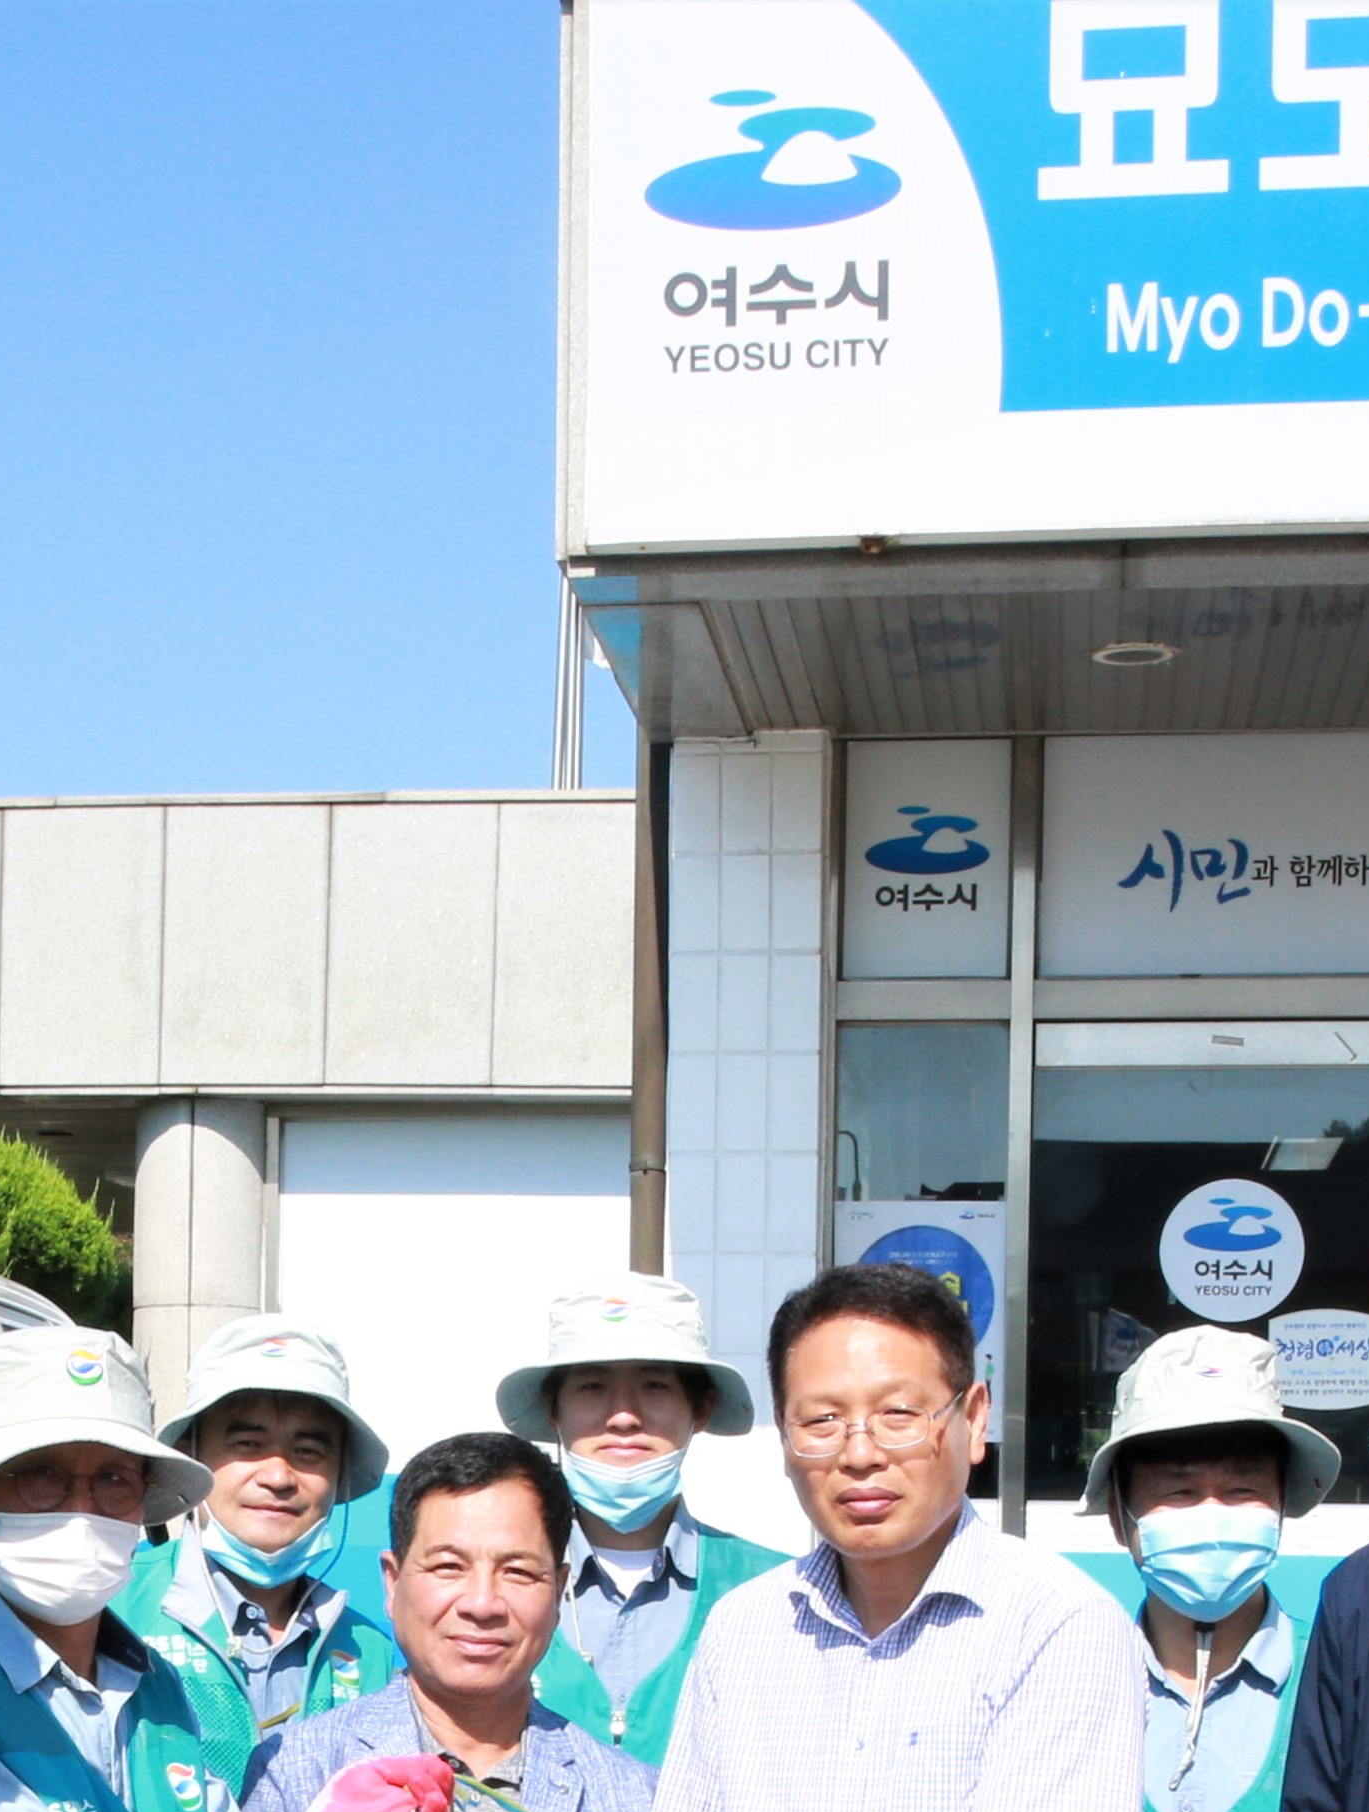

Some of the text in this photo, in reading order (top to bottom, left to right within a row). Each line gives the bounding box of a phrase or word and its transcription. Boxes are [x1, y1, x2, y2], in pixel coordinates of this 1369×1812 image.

[663, 259, 890, 328] 여수시
[1106, 281, 1241, 364] Myo
[664, 338, 890, 374] YEOSU CITY
[875, 883, 977, 912] 여수시
[1194, 1259, 1273, 1281] 여수시
[1195, 1285, 1273, 1296] YEOSU CITY
